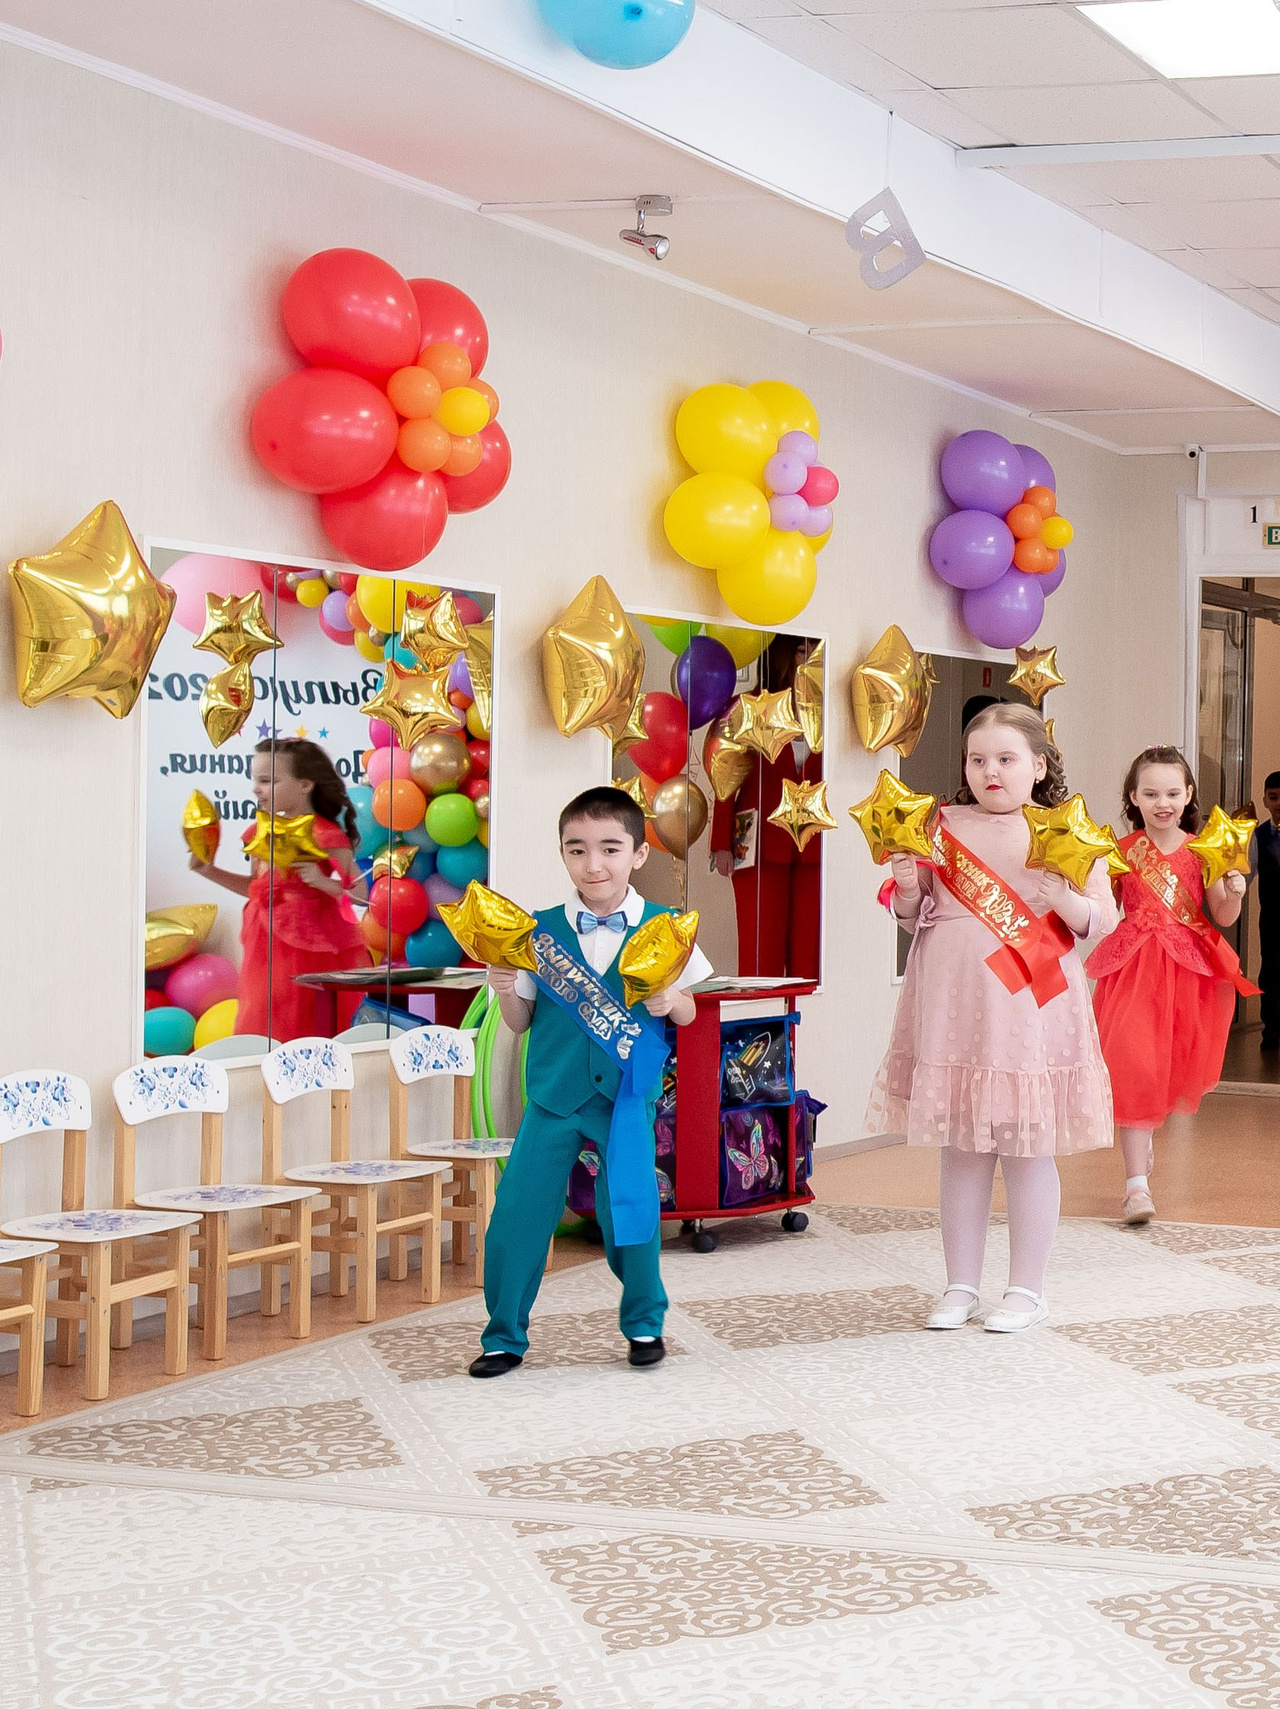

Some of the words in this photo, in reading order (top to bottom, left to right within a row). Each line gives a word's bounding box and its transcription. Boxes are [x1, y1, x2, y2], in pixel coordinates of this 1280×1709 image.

[1250, 505, 1259, 523] 1
[533, 932, 627, 1034] Выпускник
[578, 1001, 613, 1041] САДА
